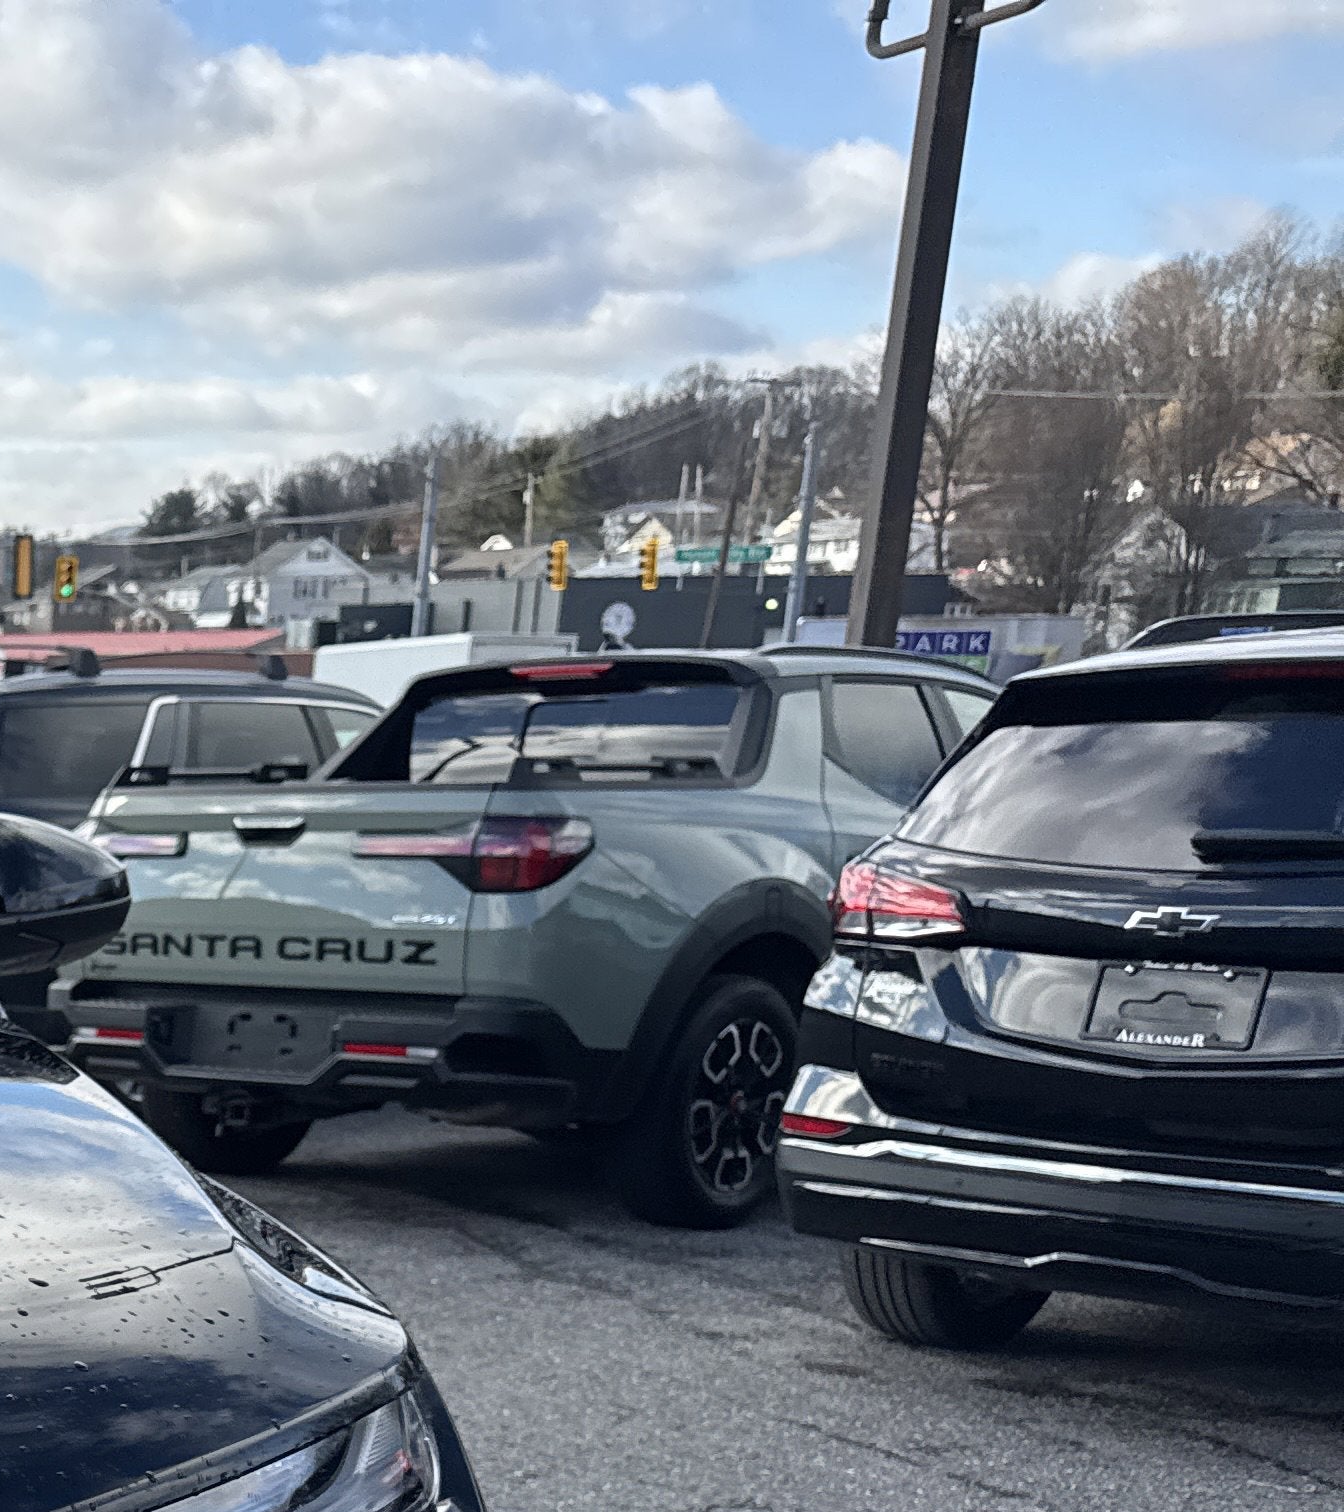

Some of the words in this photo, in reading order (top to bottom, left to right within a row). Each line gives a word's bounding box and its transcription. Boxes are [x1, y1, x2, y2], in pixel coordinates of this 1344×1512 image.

[102, 932, 263, 960] SANTA
[276, 936, 438, 967] CRUZ
[1115, 1028, 1206, 1048] ALEXANDER
